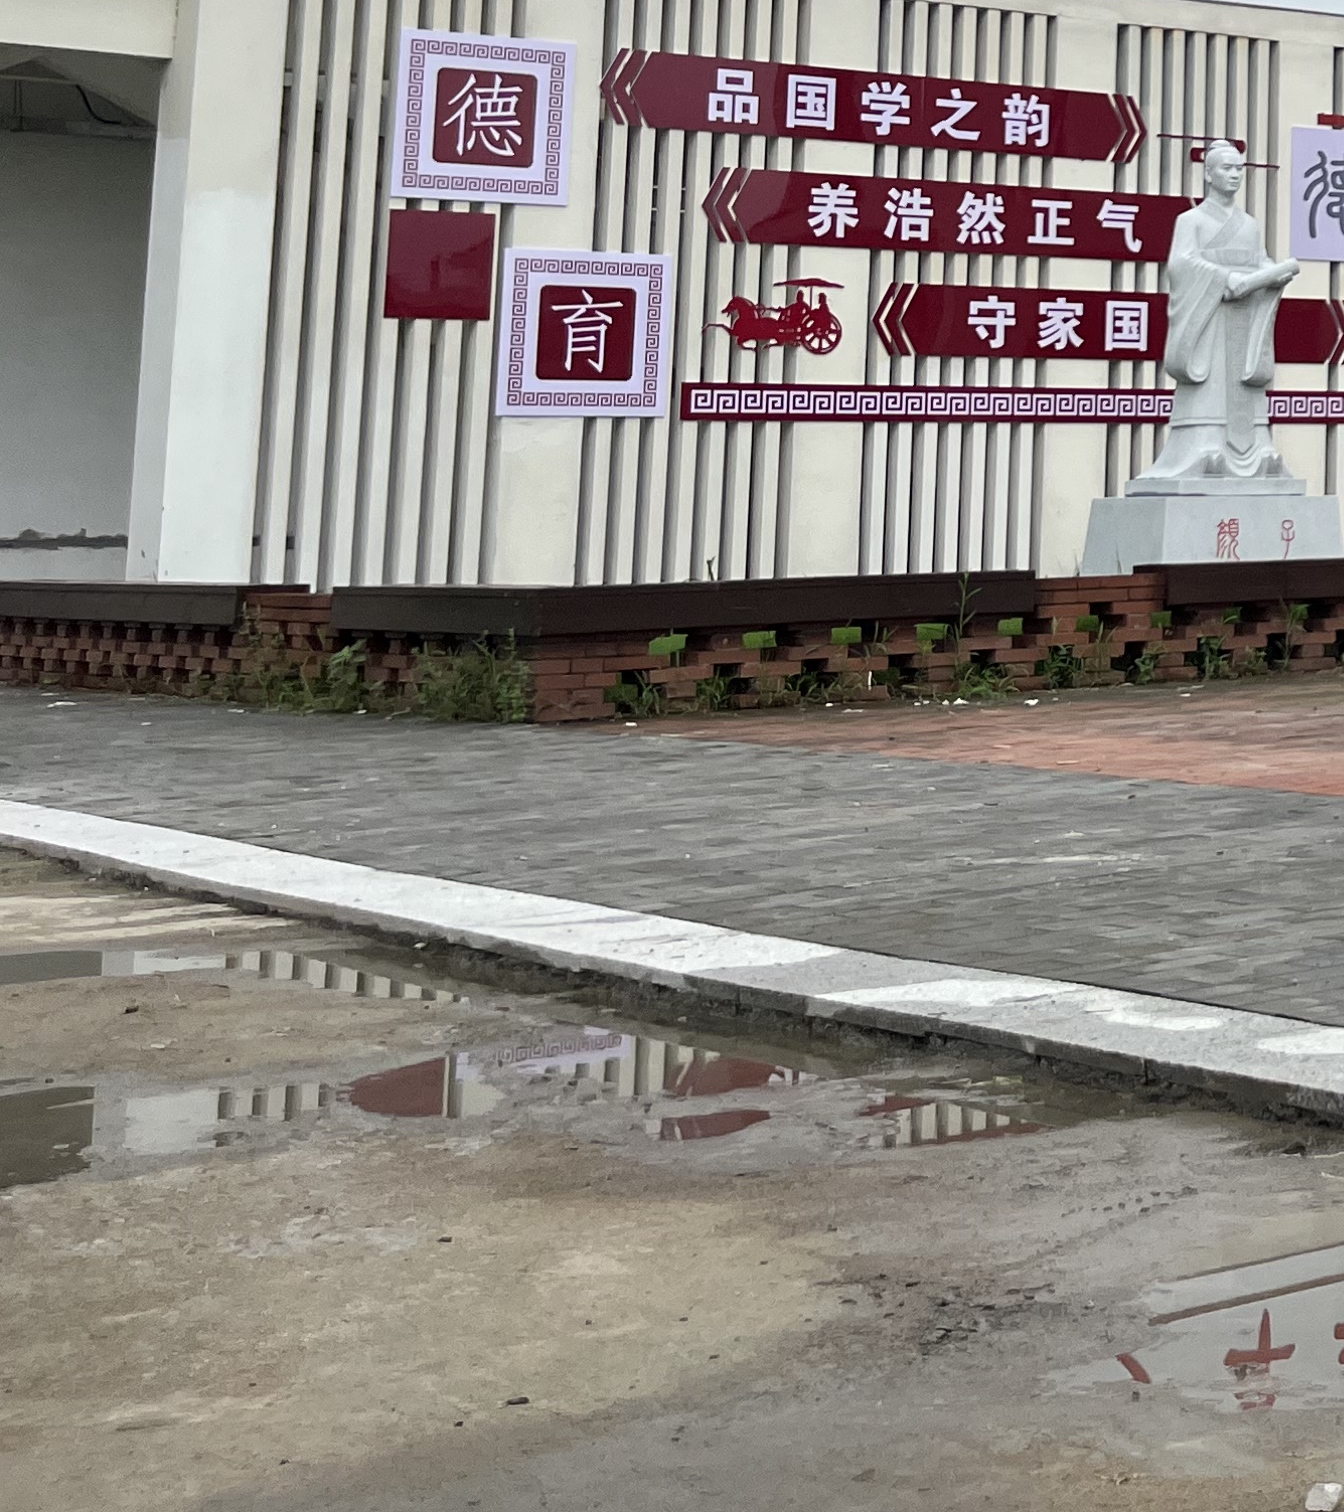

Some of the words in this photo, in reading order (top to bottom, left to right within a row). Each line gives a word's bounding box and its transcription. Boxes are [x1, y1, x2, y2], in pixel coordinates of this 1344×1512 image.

[441, 70, 525, 159] 德
[706, 66, 1053, 150] 品国学之韵
[806, 180, 1143, 253] 养浩然正气
[550, 289, 625, 374] 育
